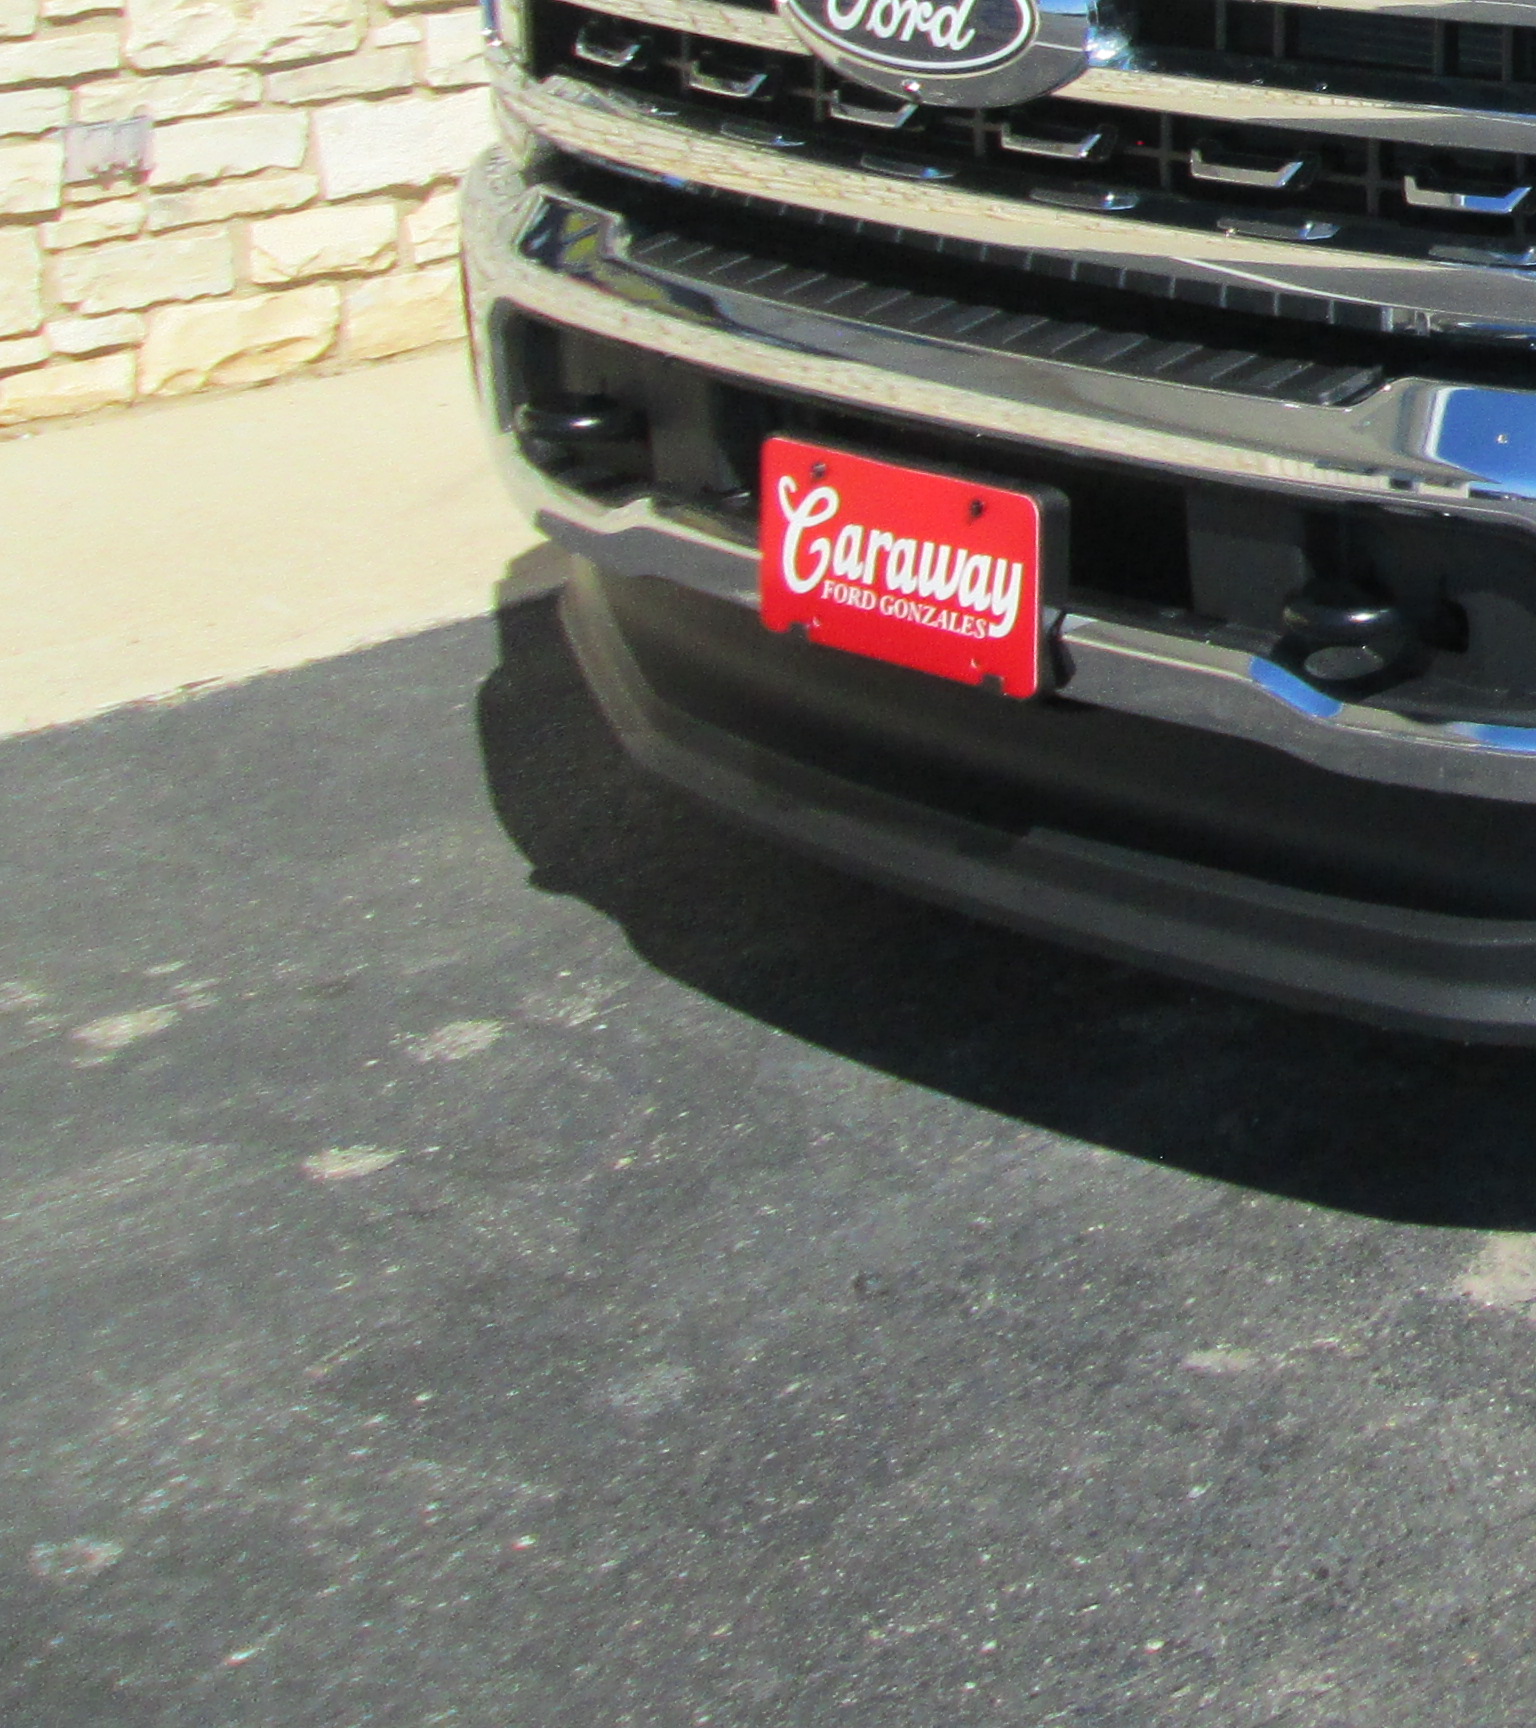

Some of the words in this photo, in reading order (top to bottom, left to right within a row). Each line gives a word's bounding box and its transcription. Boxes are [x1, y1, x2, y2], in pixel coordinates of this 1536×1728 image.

[777, 475, 1023, 638] Caraway
[820, 578, 877, 612] FORD
[878, 595, 987, 639] GONZALES
